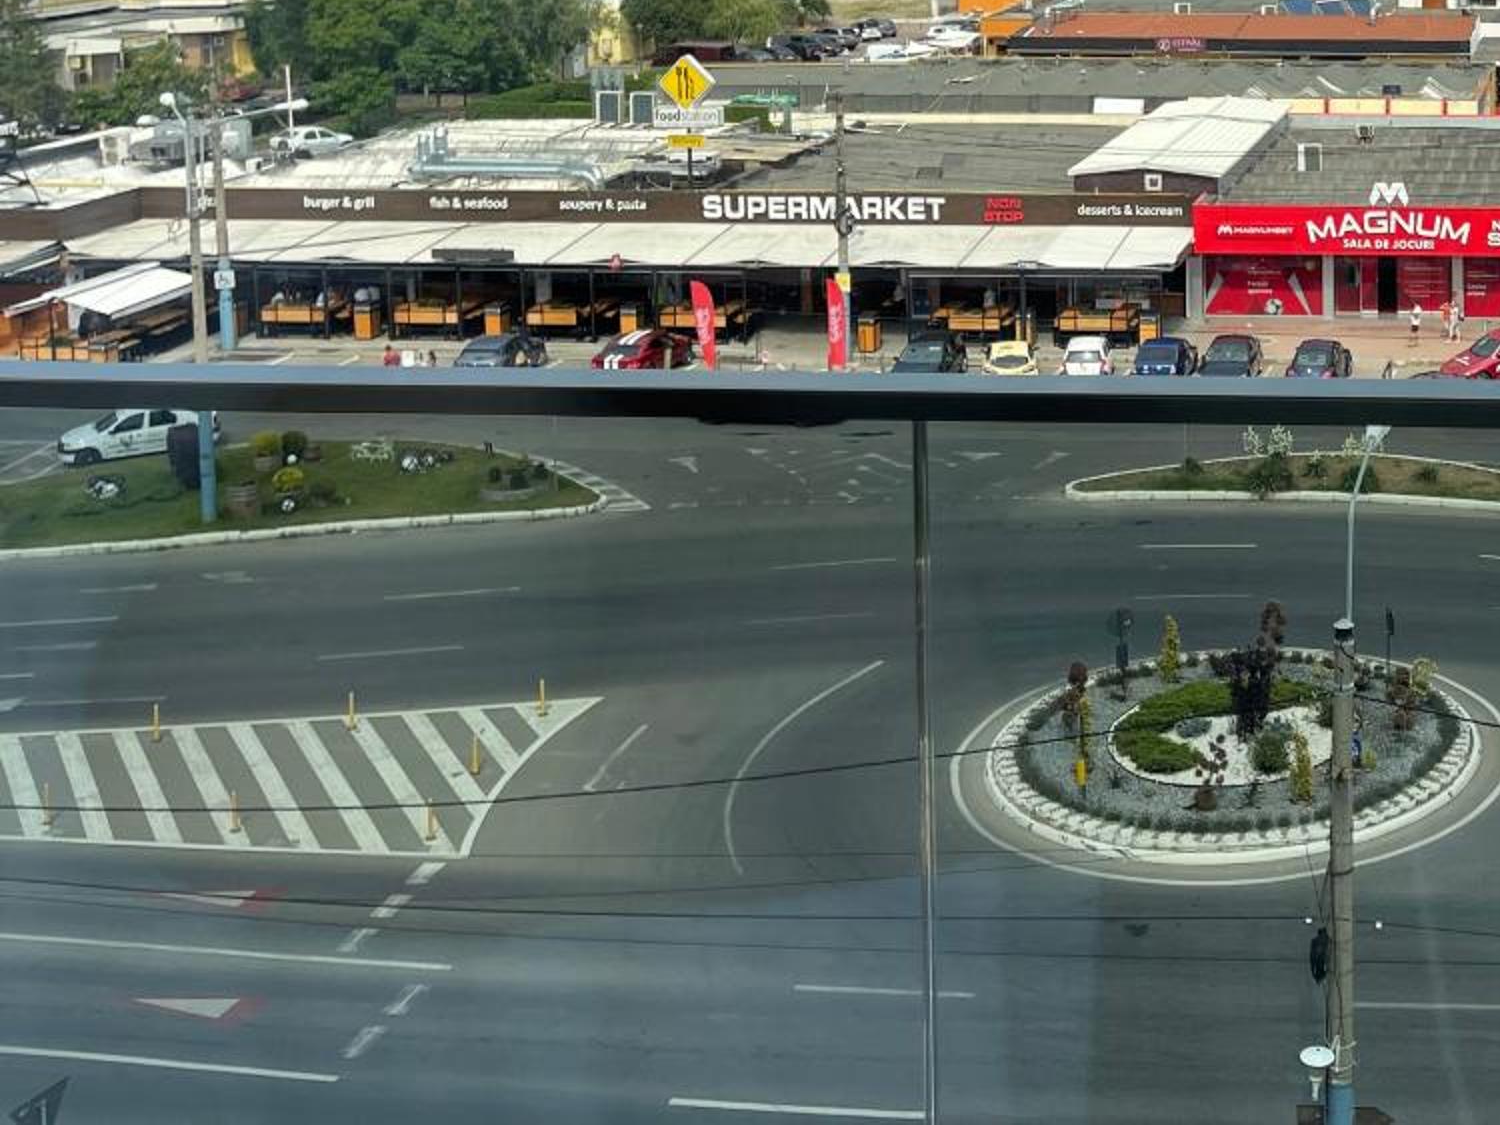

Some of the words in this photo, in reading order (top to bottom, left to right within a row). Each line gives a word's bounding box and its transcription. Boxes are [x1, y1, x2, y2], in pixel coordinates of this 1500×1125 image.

[303, 195, 340, 211] burger
[341, 196, 352, 208] &
[353, 195, 375, 211] grill
[429, 195, 450, 209] fish
[452, 196, 462, 209] &
[463, 195, 510, 210] seafood
[559, 198, 603, 212] soupery
[616, 199, 648, 212] pasta
[702, 194, 946, 221] SUPERMARKET
[1077, 204, 1122, 217] desserts
[1123, 205, 1134, 216] &
[1135, 204, 1183, 217] icecream
[1305, 210, 1471, 245] MAGNUM
[1343, 238, 1371, 249] SALA
[1374, 238, 1390, 250] DE
[1393, 239, 1435, 250] JOCURI
